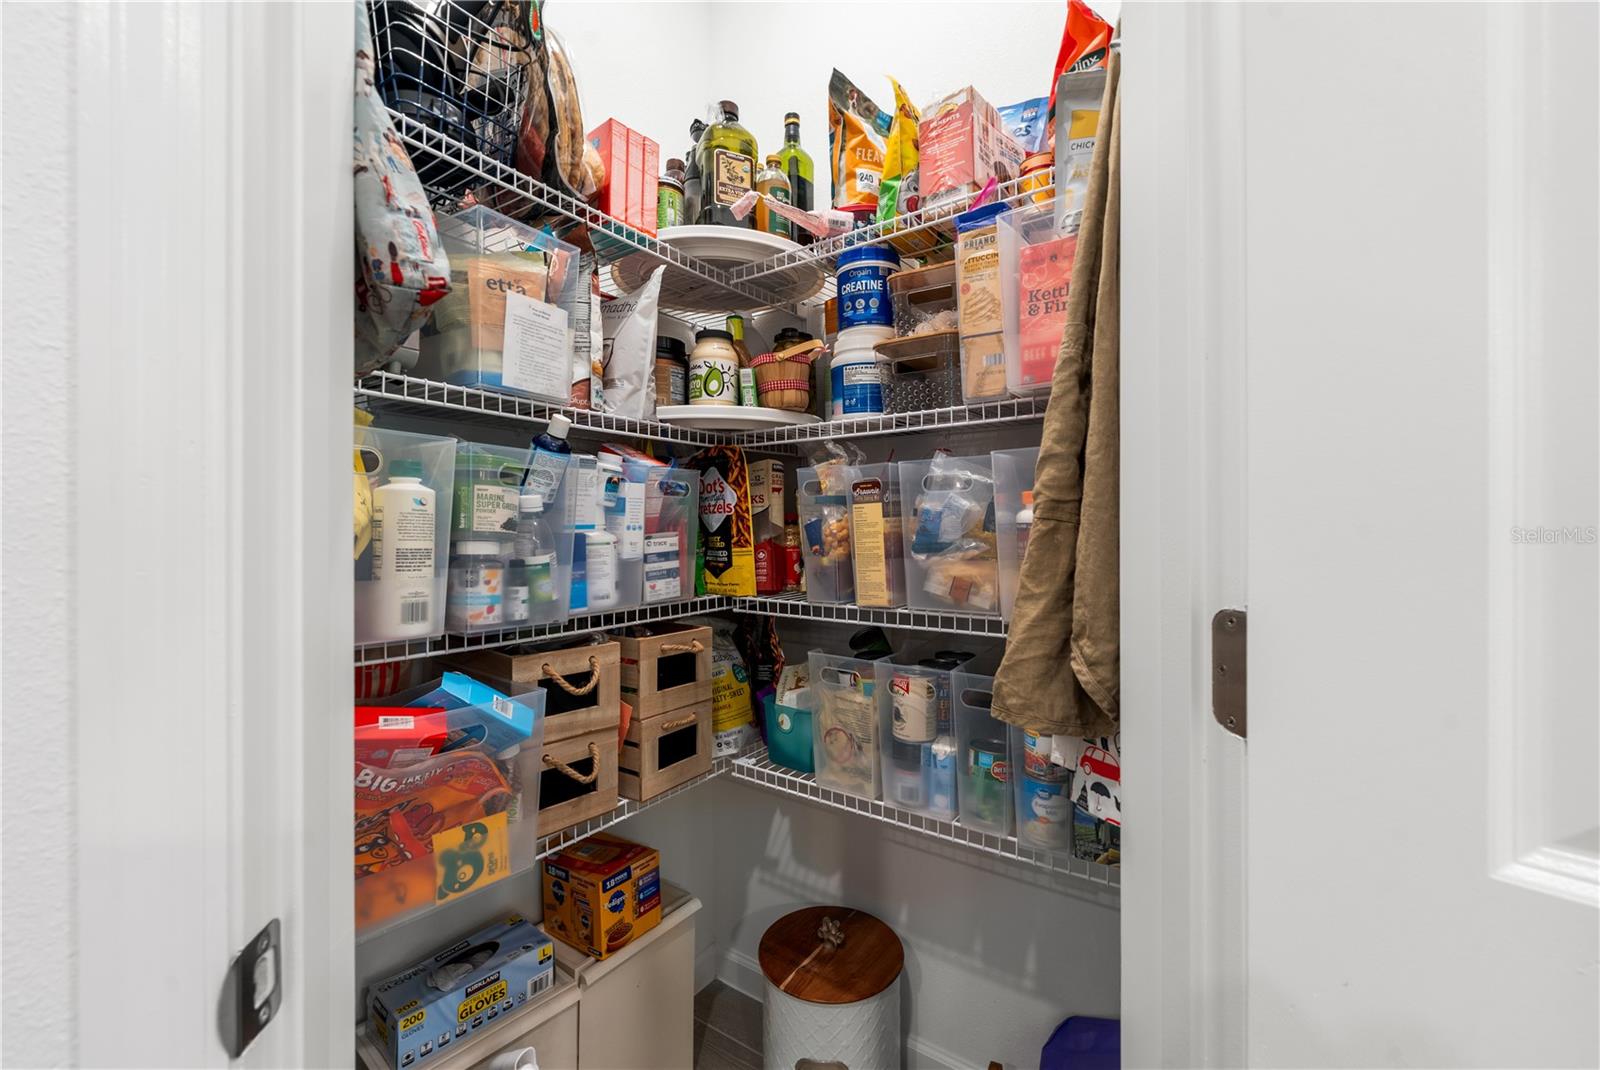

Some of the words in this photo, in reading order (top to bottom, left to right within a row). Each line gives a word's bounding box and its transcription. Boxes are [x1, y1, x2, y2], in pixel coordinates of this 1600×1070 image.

[1013, 125, 1032, 137] es
[859, 172, 874, 184] 240
[964, 235, 996, 248] PRIANO
[849, 268, 872, 278] Orgain
[841, 280, 884, 295] CREATINE
[1027, 282, 1070, 303] Kettl
[1028, 303, 1040, 316] &
[1043, 299, 1068, 315] Fir
[476, 501, 500, 510] SUPER
[751, 494, 765, 505] KS
[702, 499, 733, 515] retzels
[355, 768, 397, 793] BIG
[606, 879, 616, 890] 18
[543, 949, 549, 957] L
[467, 973, 500, 993] KIRKLAND
[396, 1000, 418, 1014] 200
[460, 988, 506, 1020] GLOVES
[403, 1011, 424, 1029] 200
